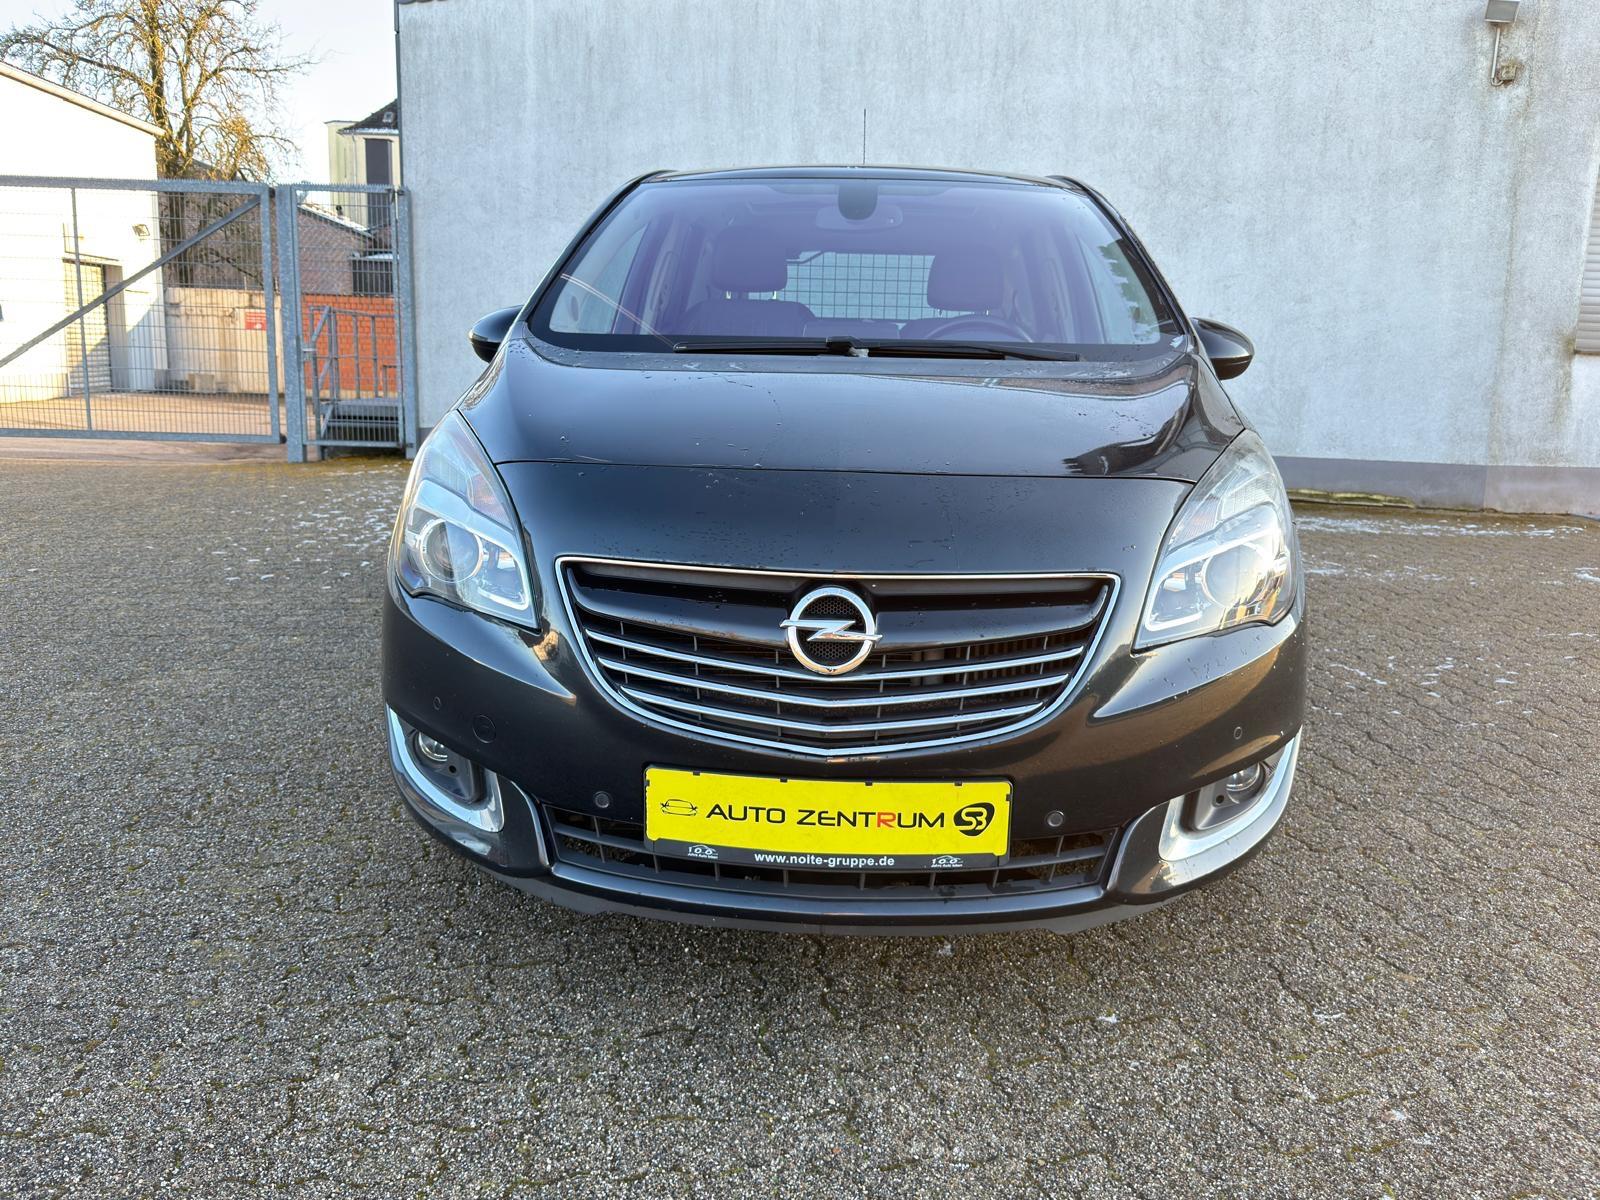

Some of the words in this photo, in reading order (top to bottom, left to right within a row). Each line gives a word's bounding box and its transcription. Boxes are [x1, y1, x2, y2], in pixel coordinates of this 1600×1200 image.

[706, 803, 785, 824] AUTO
[796, 809, 945, 829] ZENTRUM
[754, 853, 895, 868] www.nolte-gruppe.de
